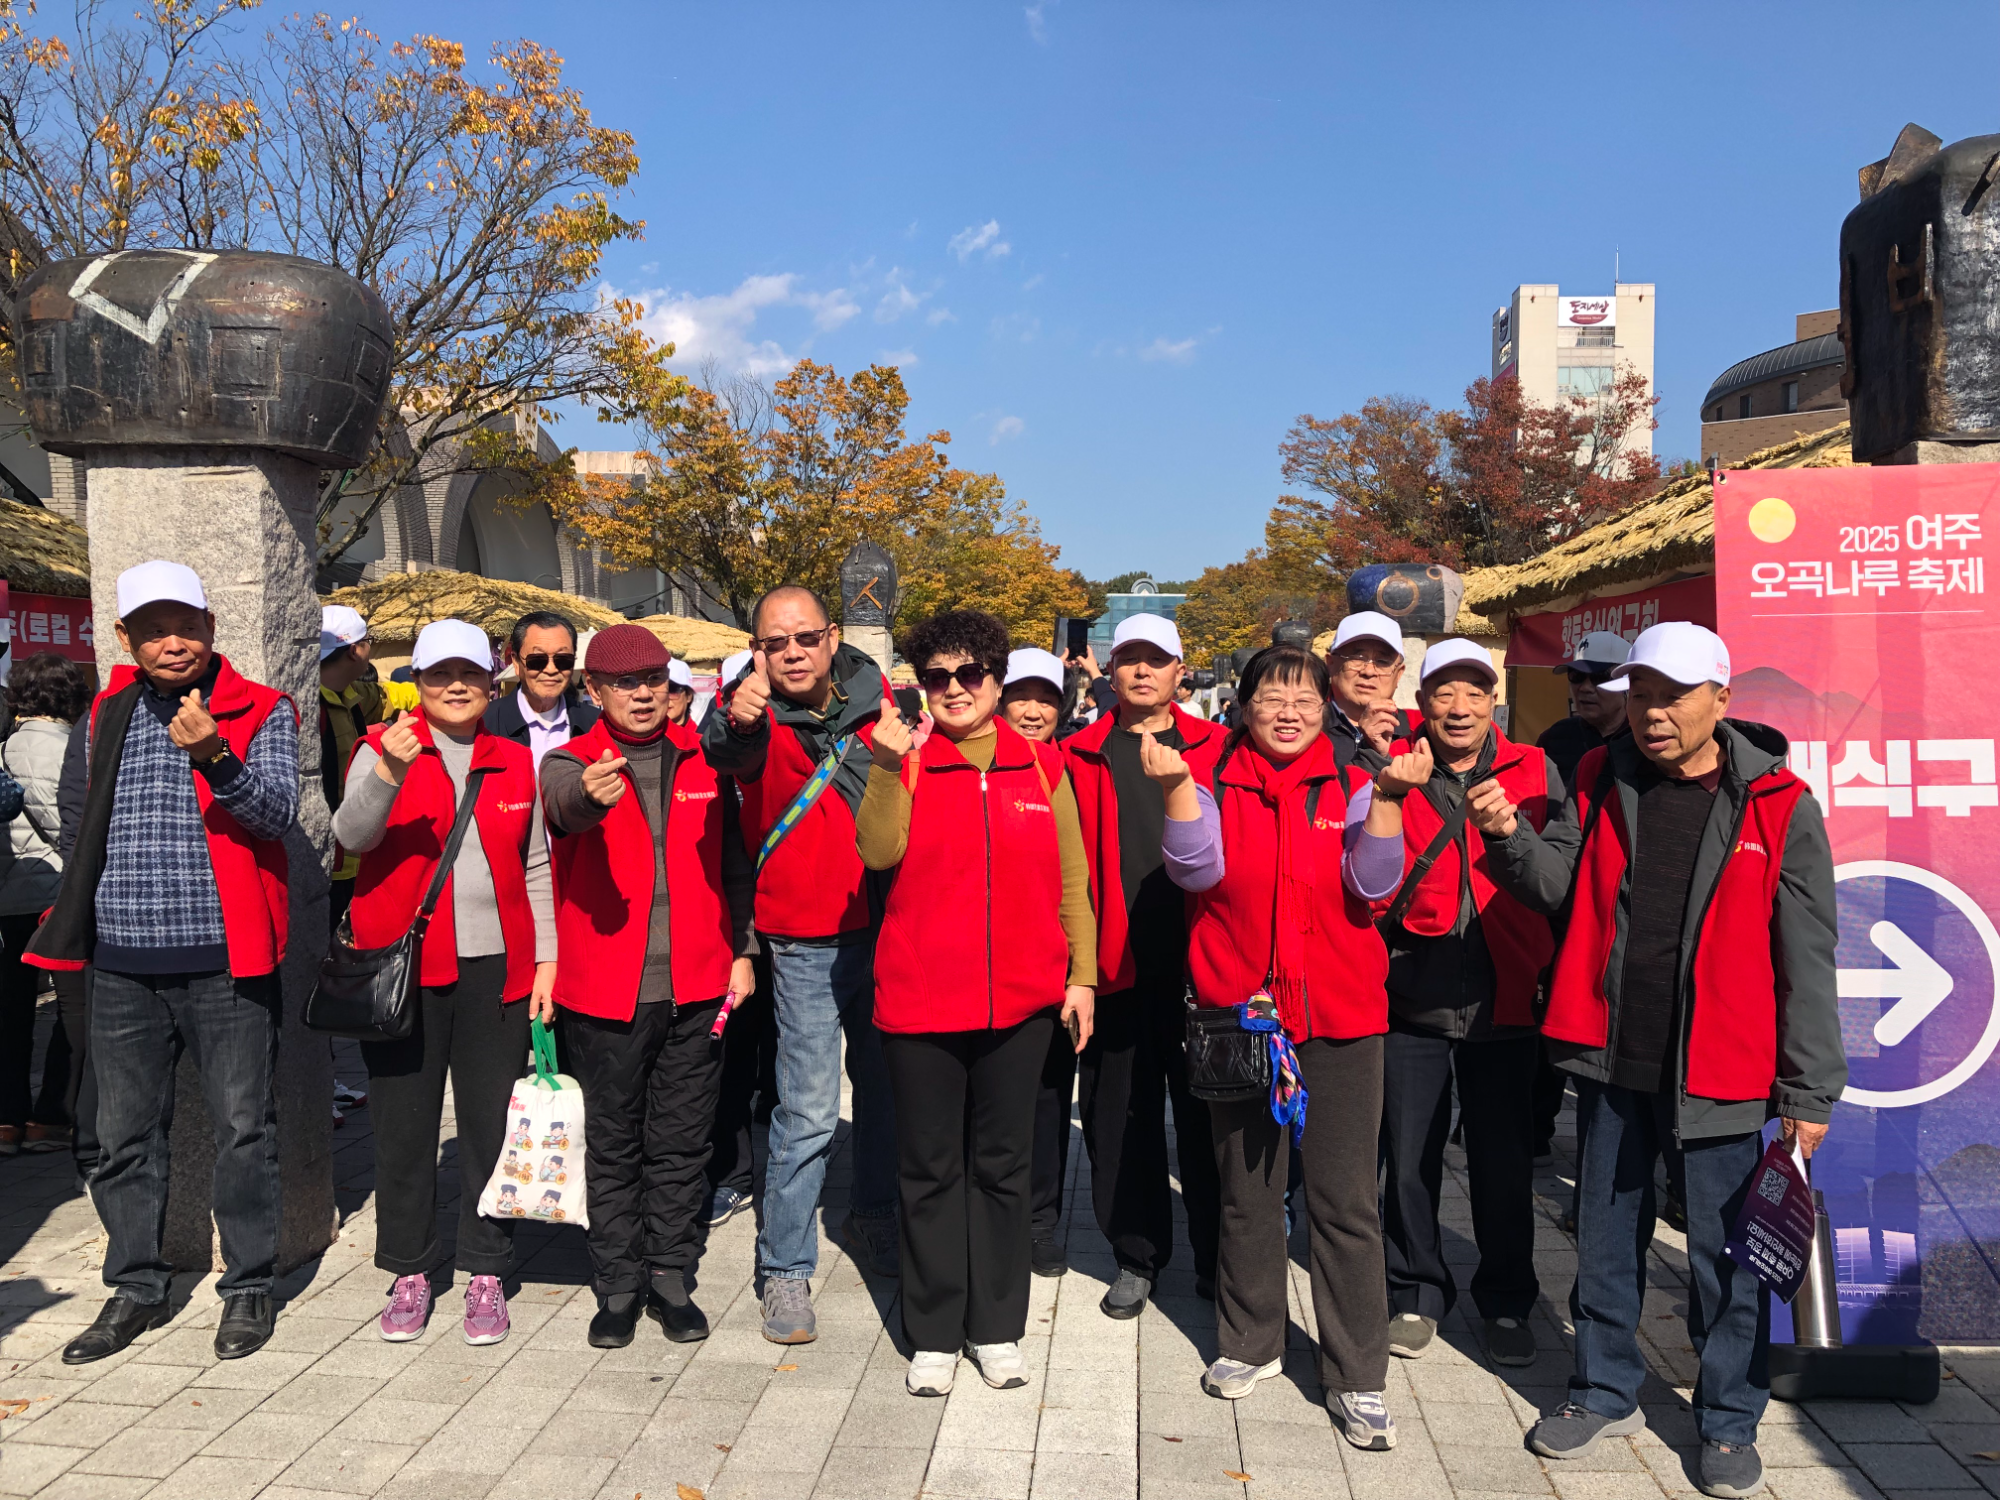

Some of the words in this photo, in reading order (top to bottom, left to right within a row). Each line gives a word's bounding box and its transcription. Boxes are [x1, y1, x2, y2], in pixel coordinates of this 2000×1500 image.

[1839, 526, 1899, 552] 2025
[1906, 513, 1982, 550] 여주
[1750, 560, 1901, 598] 오곡나루
[1907, 557, 1984, 595] 축제
